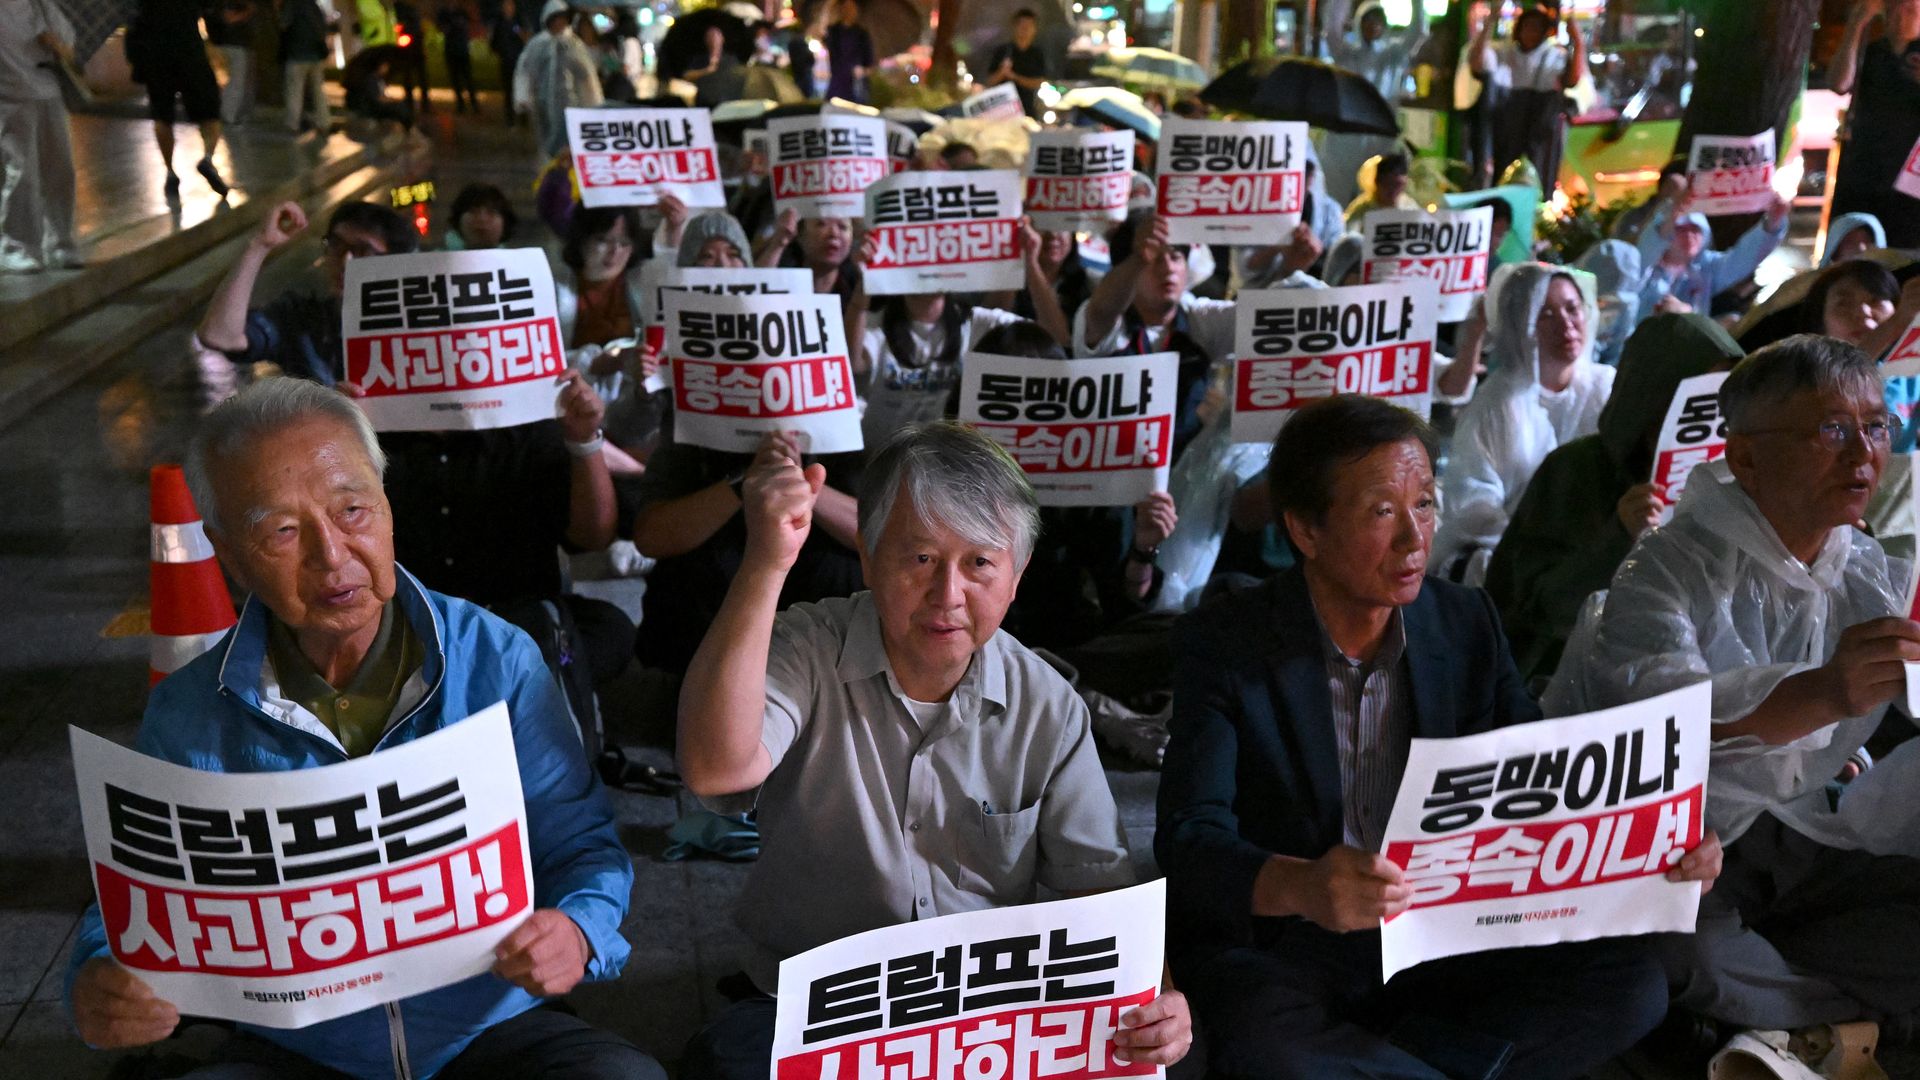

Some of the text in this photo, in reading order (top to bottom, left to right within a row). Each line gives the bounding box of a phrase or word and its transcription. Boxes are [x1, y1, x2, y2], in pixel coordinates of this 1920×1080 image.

[580, 118, 693, 150] 동맹이냐
[779, 128, 873, 161] 트럼프는
[1034, 144, 1125, 175] 트럼프는
[1170, 134, 1292, 172] 동맹이냐
[873, 184, 999, 224] 트럼프는
[873, 221, 1013, 265] 사과하라!
[360, 269, 535, 331] 트럼프는
[1252, 296, 1414, 356] 동맹이냐
[361, 324, 557, 391] 사과하라!
[678, 309, 828, 361] 동맹이냐
[683, 360, 846, 415] 종속이냐!
[977, 369, 1153, 422] 동맹이냐
[1248, 347, 1420, 407] 종속이냐!
[1420, 715, 1681, 834] 동맹이냐
[104, 777, 467, 887] 트럼프는
[1405, 798, 1691, 899] 종속이냐!
[120, 839, 509, 971] 사과하라!
[802, 927, 1119, 1046] 트럼프는
[808, 1004, 1142, 1080] 과하라
